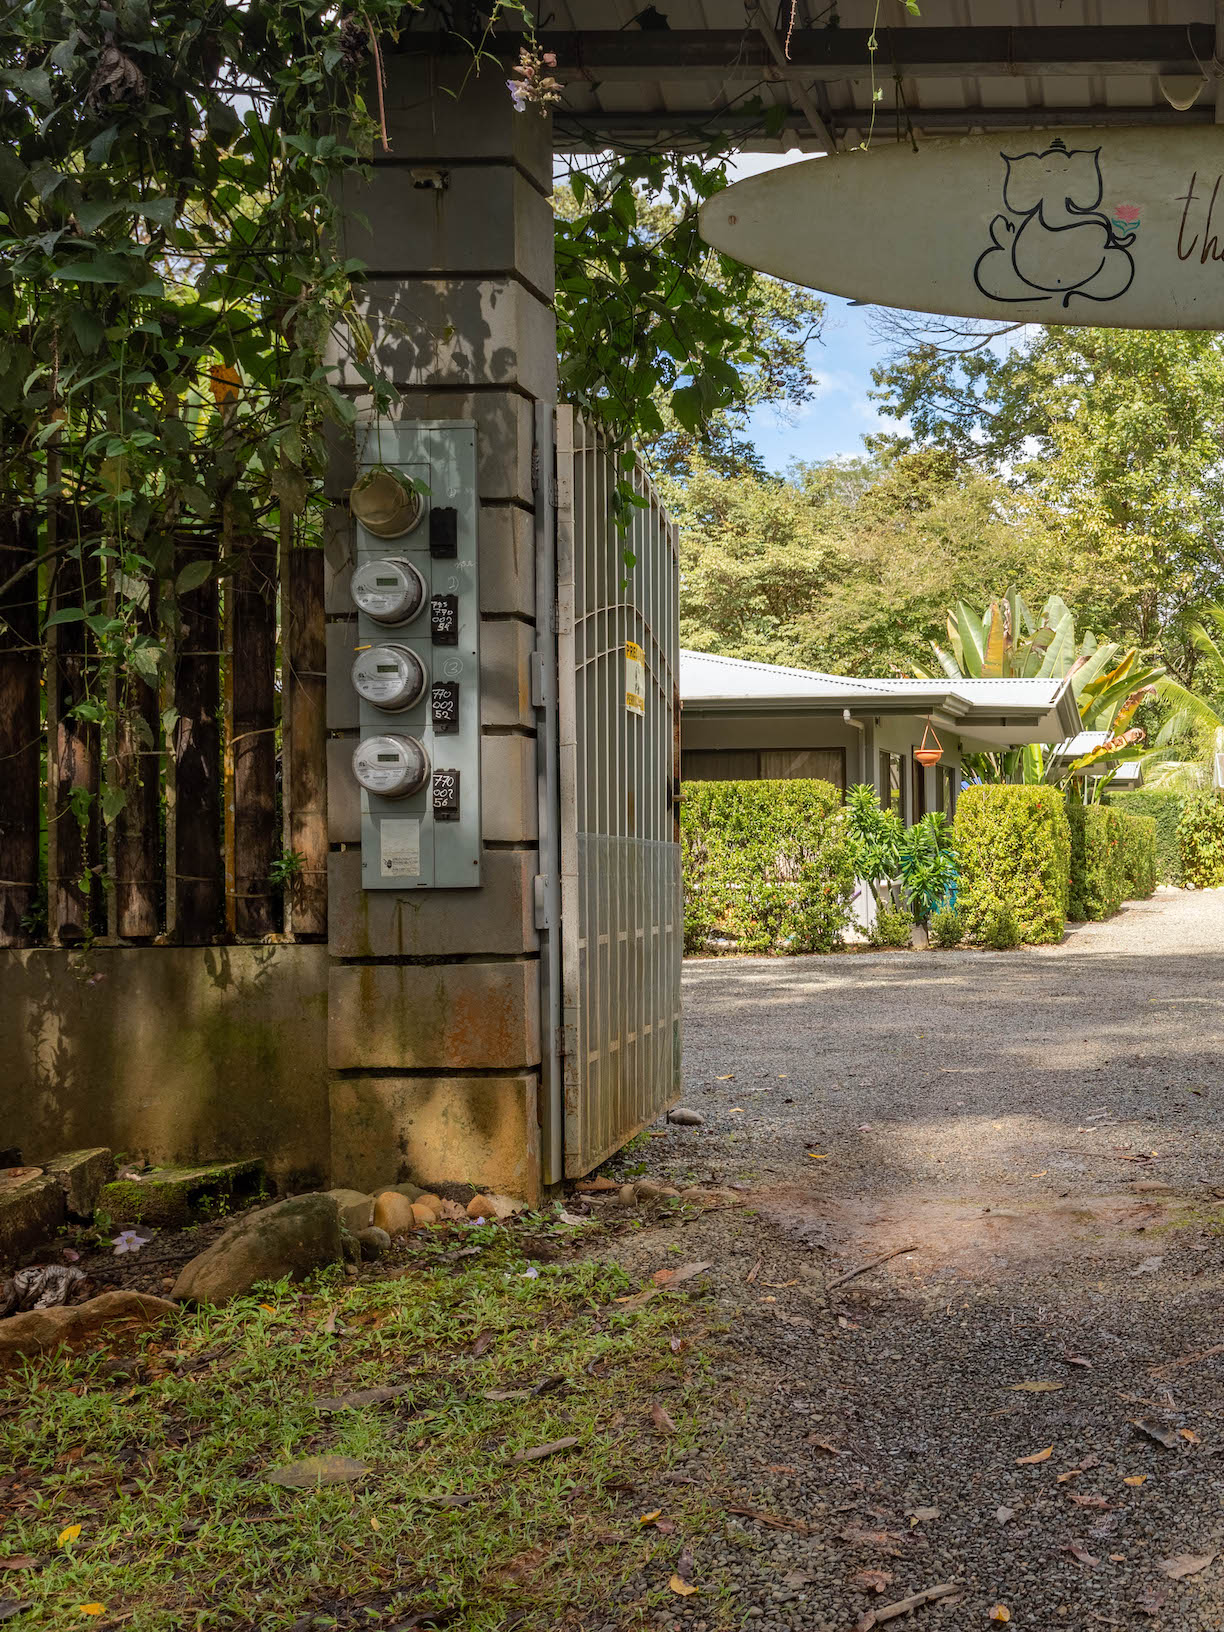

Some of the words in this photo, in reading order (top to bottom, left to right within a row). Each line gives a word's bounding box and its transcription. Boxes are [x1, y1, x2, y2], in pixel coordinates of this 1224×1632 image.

[432, 701, 454, 712] 002
[435, 710, 451, 720] 52
[432, 774, 455, 787] 770
[433, 798, 449, 808] 56
